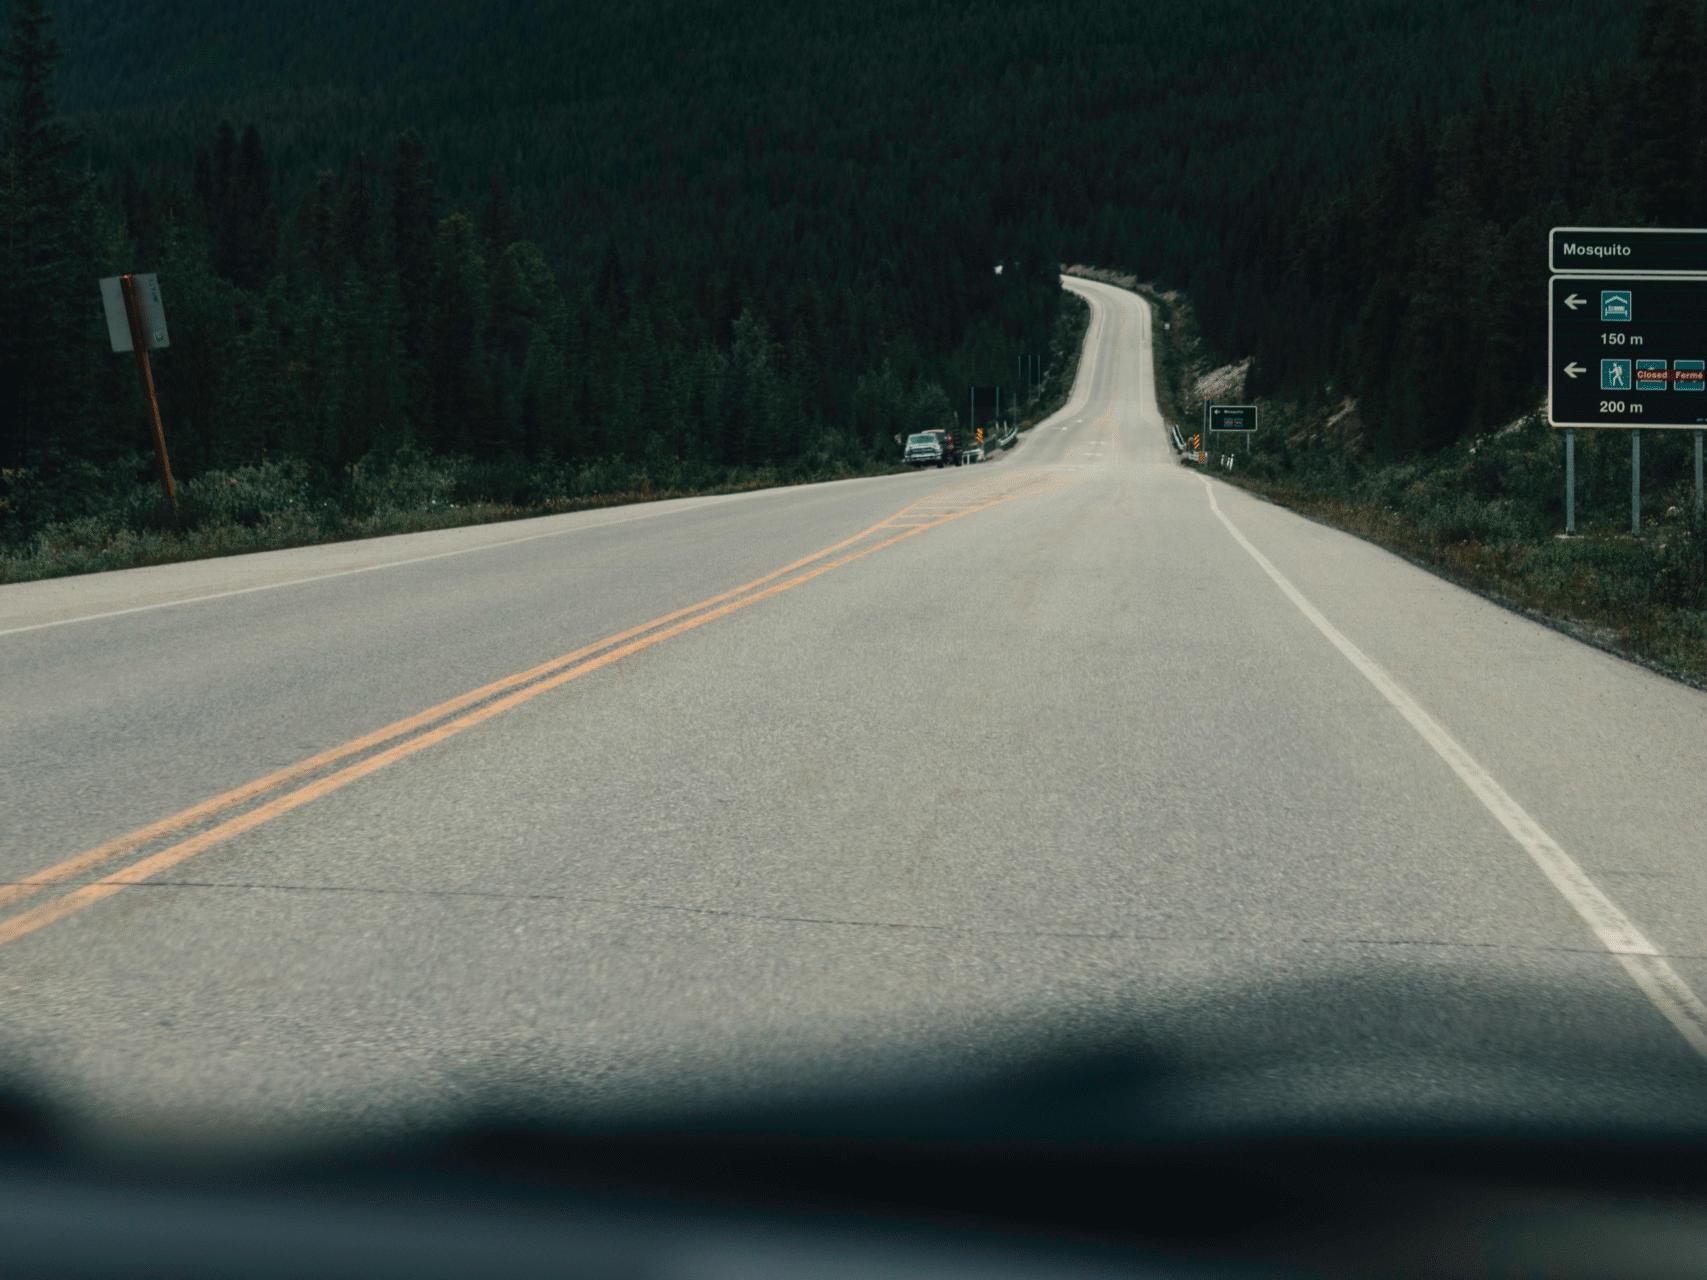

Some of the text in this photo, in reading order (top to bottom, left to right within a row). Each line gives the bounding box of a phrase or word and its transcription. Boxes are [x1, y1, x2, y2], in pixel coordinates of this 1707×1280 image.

[1563, 243, 1631, 258] Mosquito
[1601, 333, 1643, 345] 150 m
[1637, 370, 1668, 379] Closed
[1600, 401, 1643, 413] 200 m
